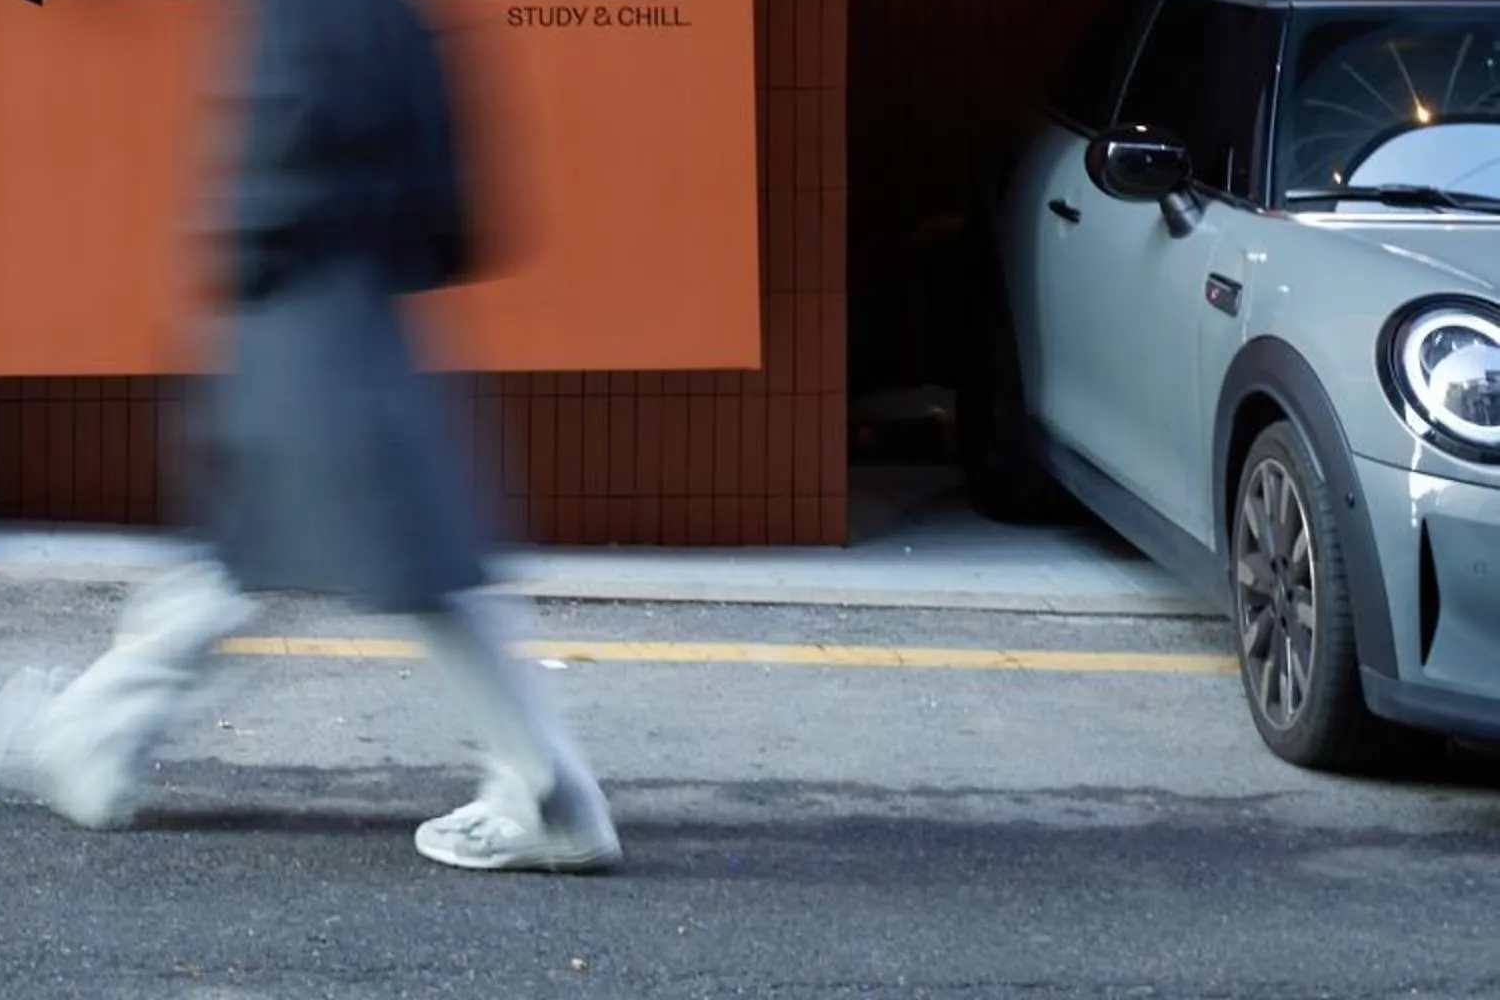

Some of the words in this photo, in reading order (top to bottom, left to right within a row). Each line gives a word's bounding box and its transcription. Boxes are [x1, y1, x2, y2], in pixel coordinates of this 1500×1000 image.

[507, 6, 588, 28] STUDY
[593, 6, 612, 28] &
[617, 6, 692, 28] CHILL.
